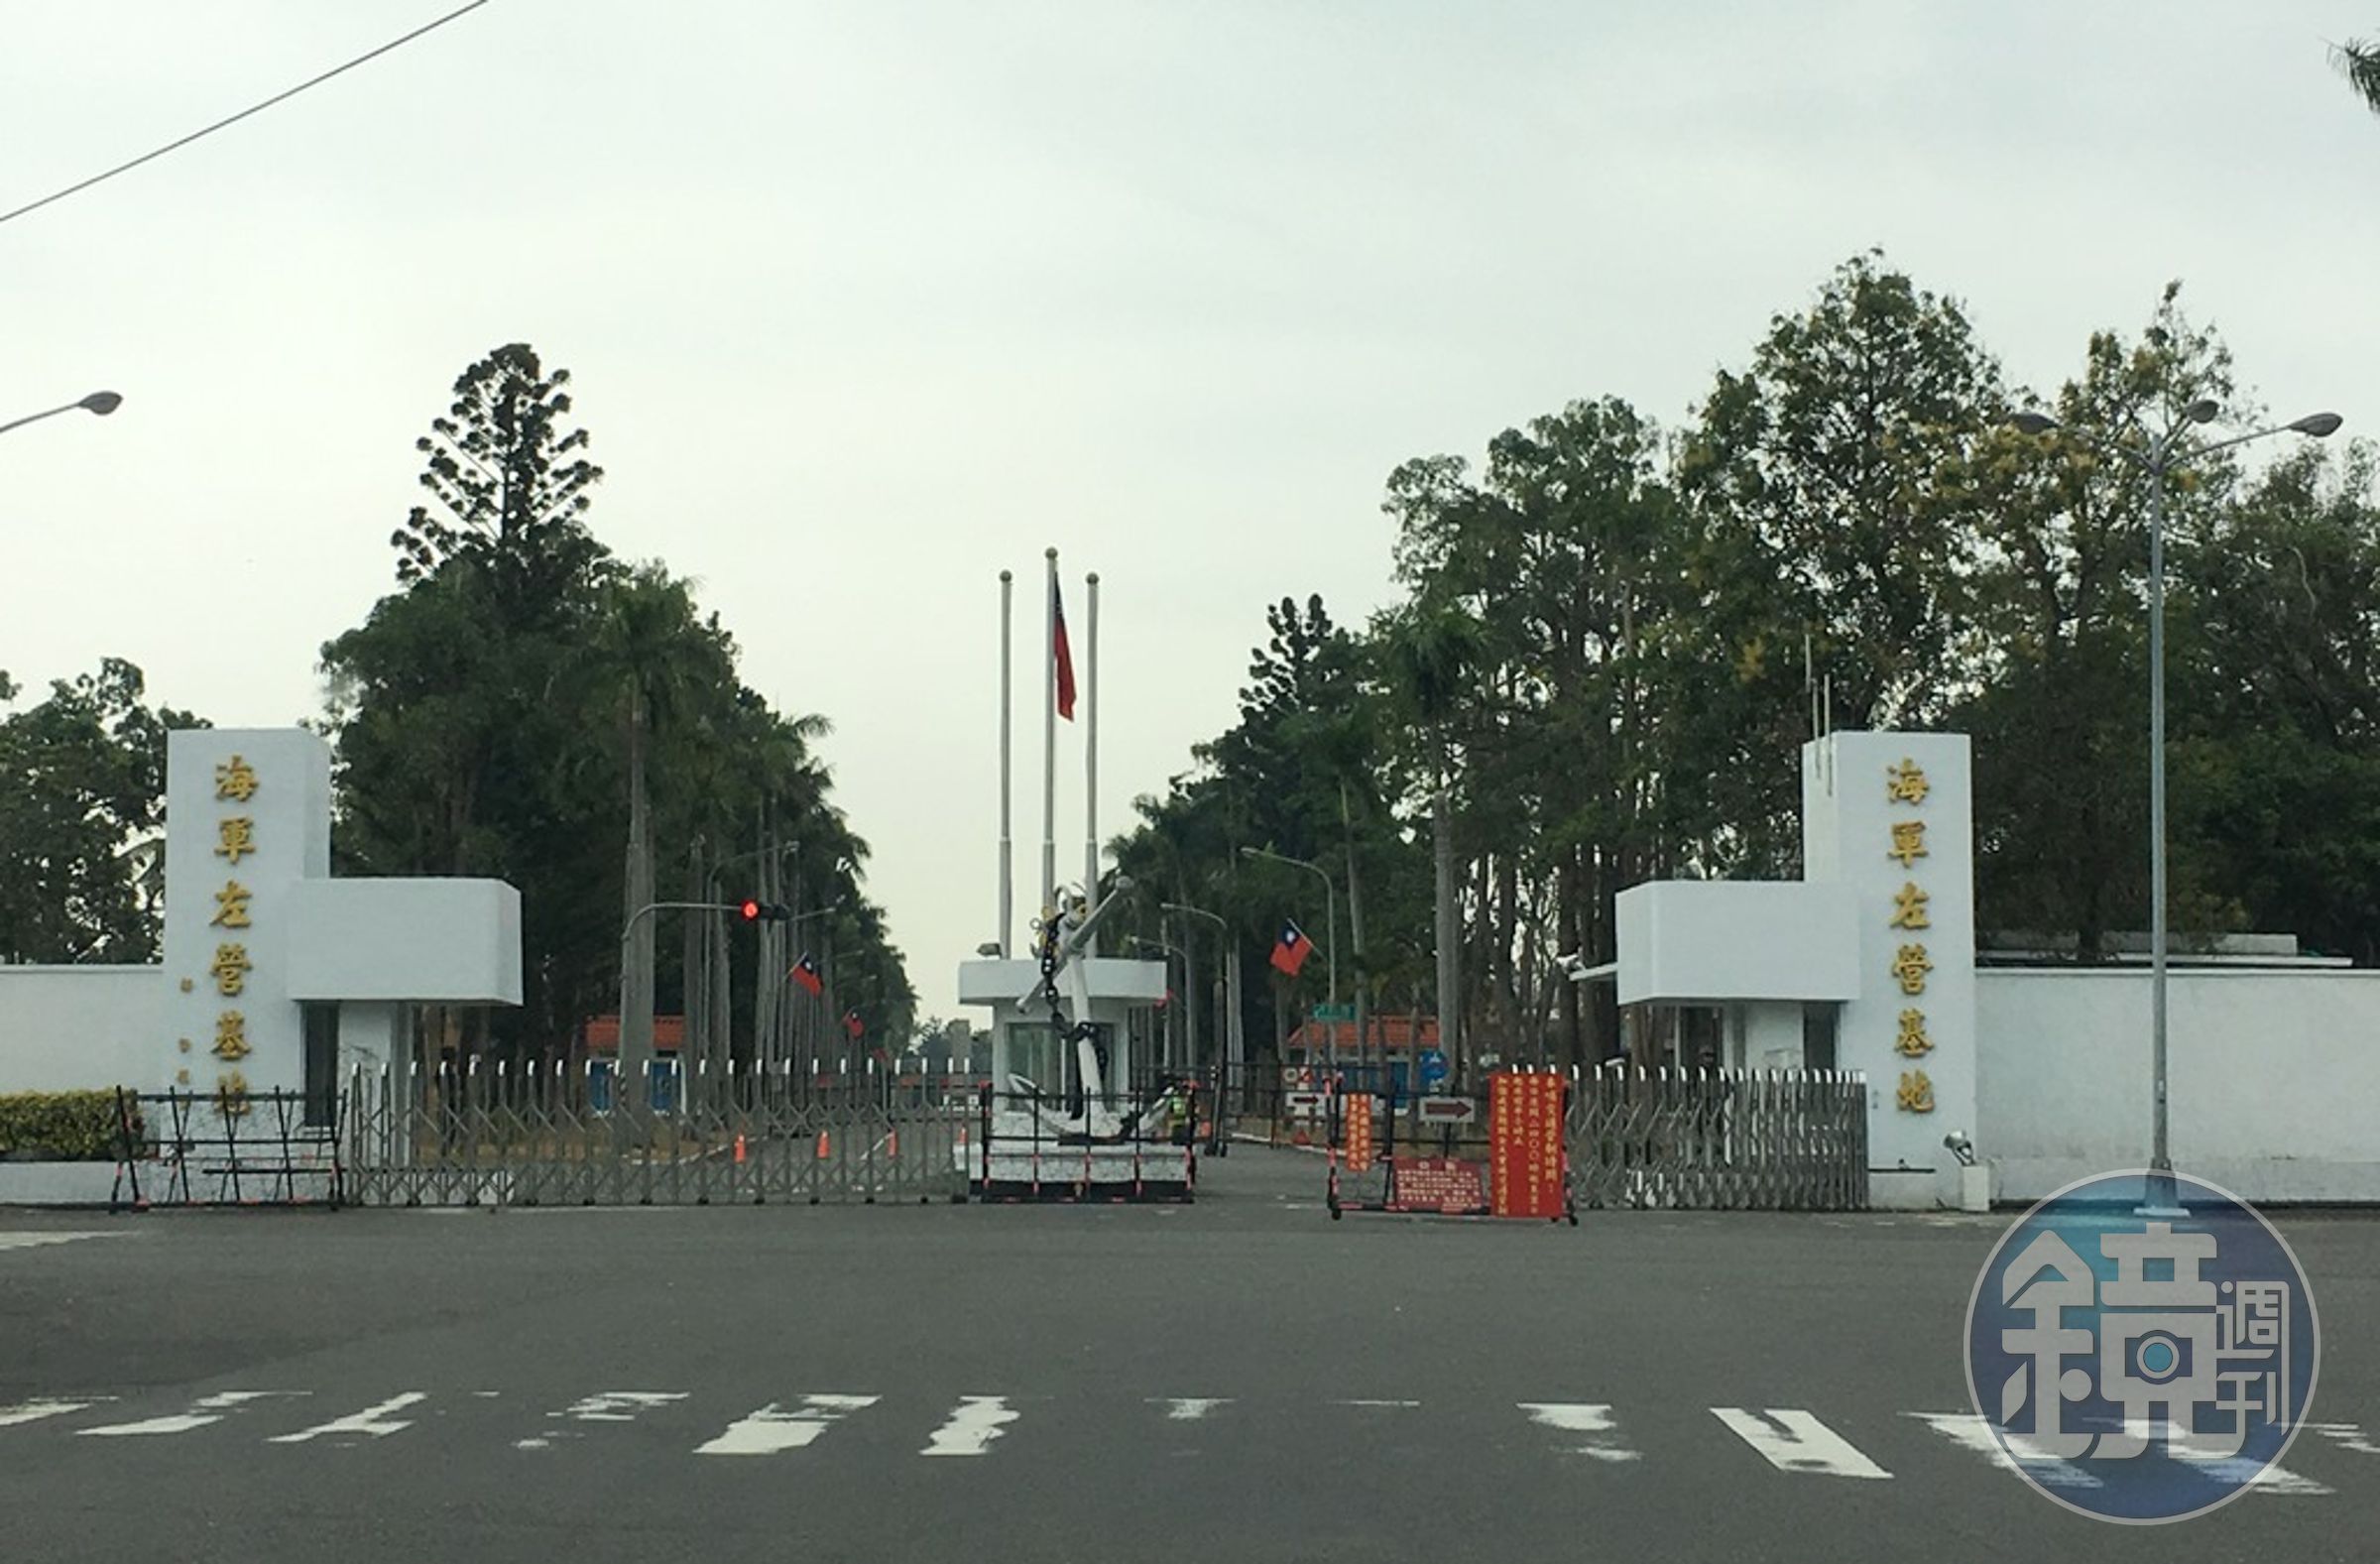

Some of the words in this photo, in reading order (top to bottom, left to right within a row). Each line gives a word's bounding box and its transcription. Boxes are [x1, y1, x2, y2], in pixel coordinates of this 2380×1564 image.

[1886, 758, 1936, 1113] 海軍左營基地
